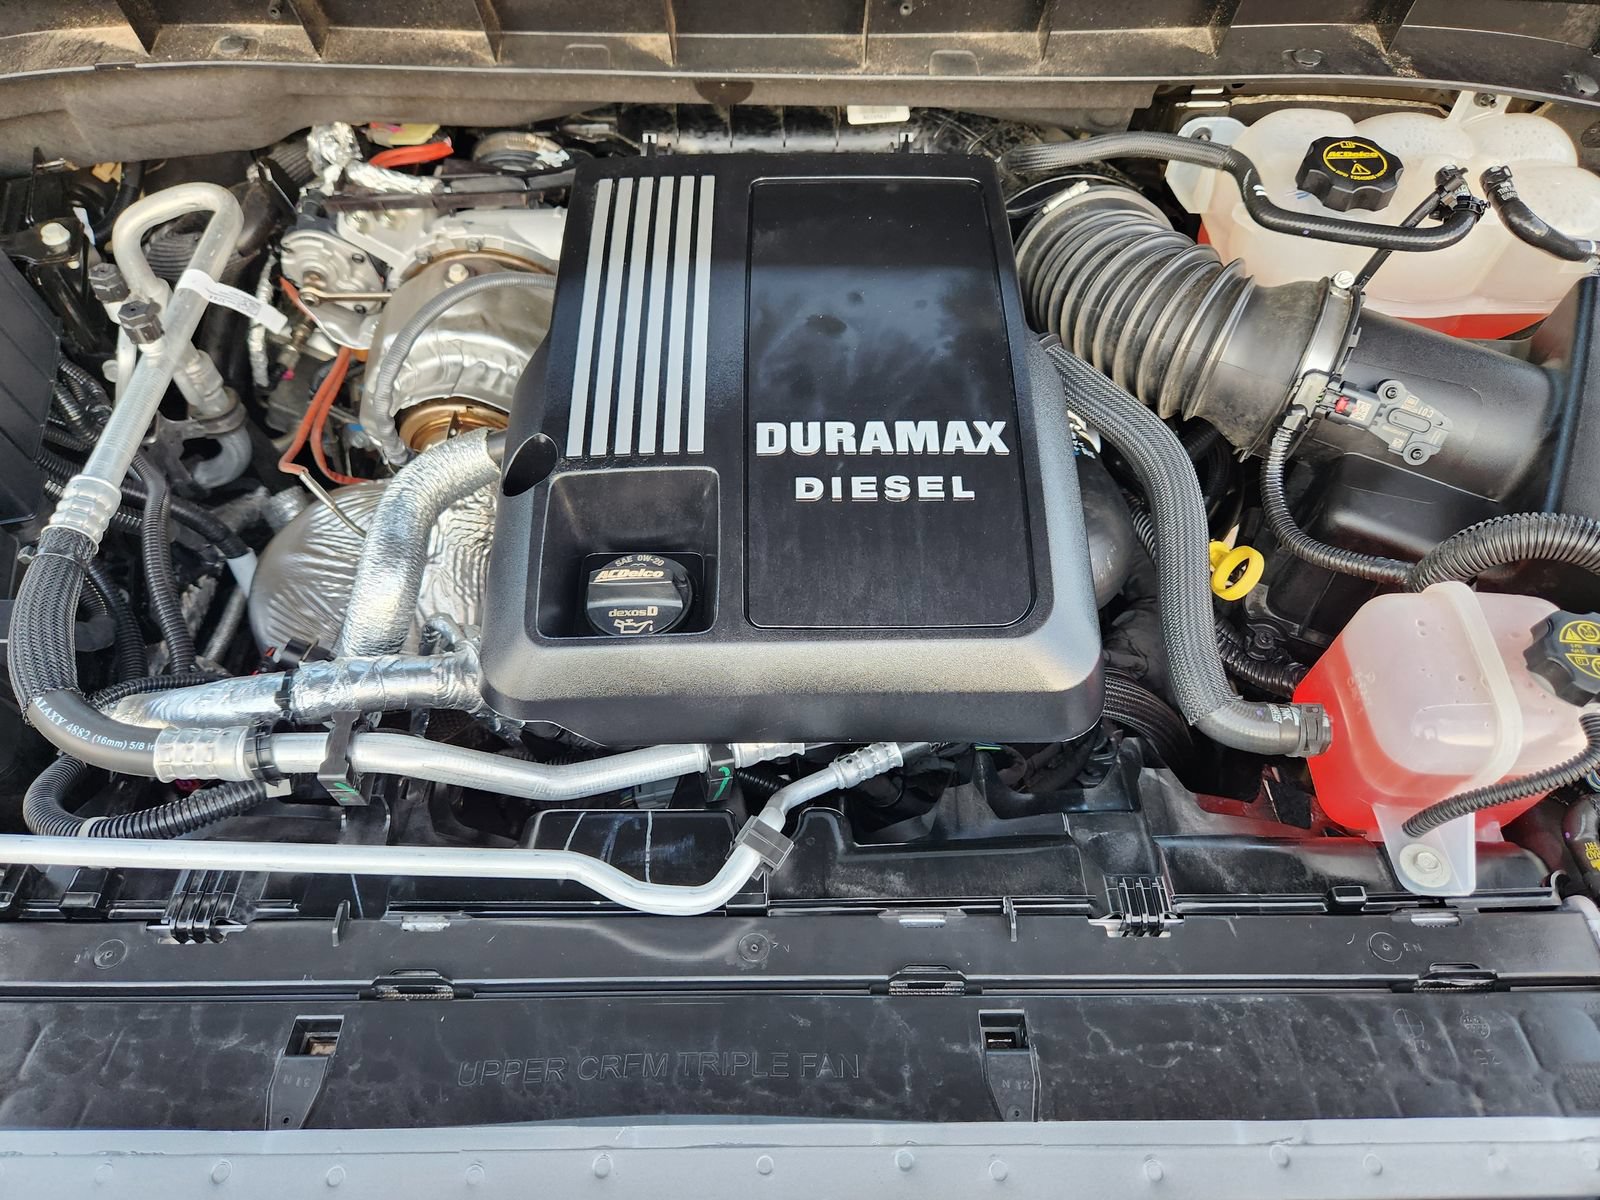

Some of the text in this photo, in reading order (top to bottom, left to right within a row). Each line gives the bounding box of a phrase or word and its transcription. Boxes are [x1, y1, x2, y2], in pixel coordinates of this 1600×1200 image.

[755, 420, 1010, 456] DURAMAX
[795, 475, 976, 502] DIESEL
[615, 554, 665, 567] SAE 0W-20
[594, 568, 665, 582] ACDelco
[66, 723, 91, 740] 4882
[92, 734, 127, 750] (16mm)
[129, 741, 146, 750] 5/8
[458, 1052, 860, 1086] UPPER CRFM TRIPLE FAN
